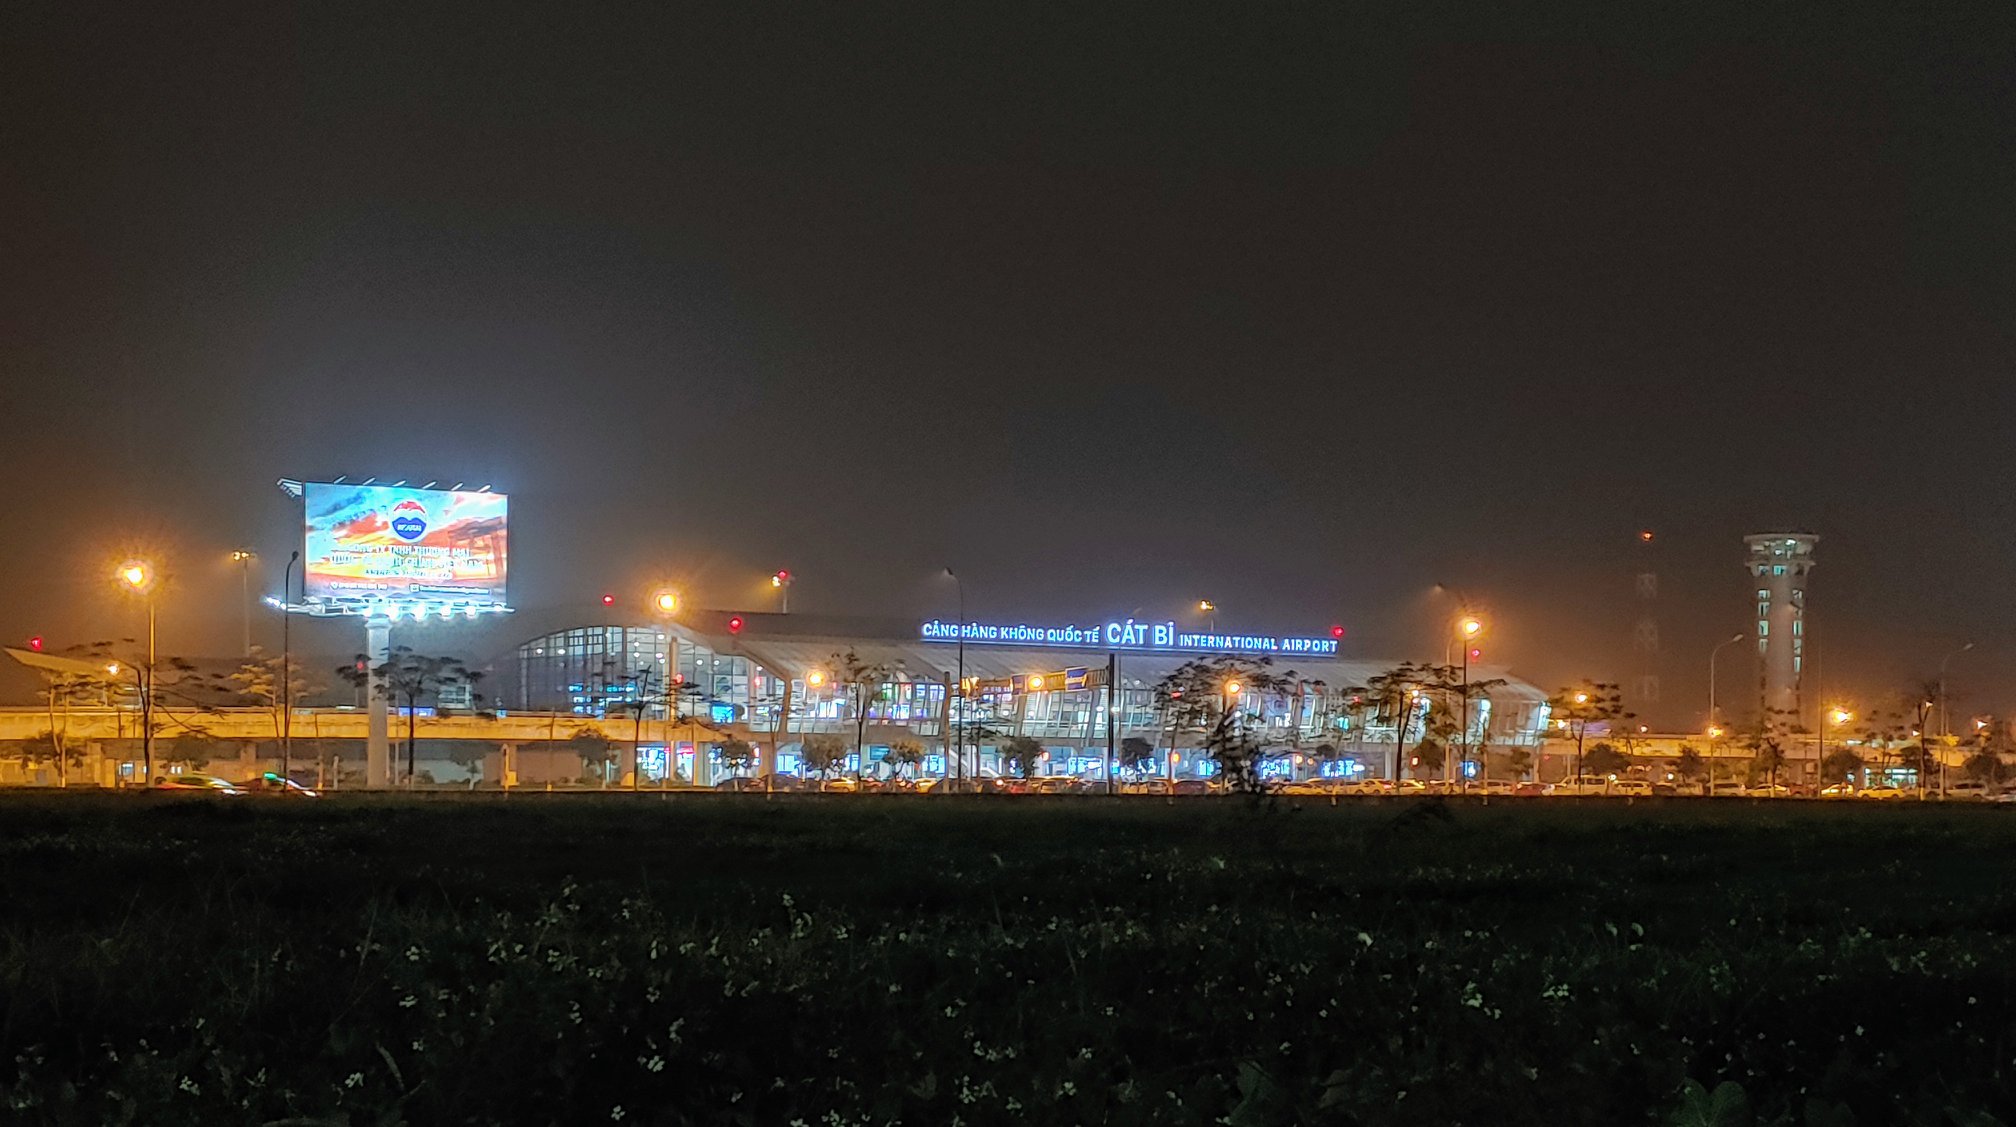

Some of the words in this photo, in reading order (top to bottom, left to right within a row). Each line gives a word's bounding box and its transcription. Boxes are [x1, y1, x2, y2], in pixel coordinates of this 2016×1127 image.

[1001, 625, 1044, 642] KHÔNG
[1047, 625, 1082, 643] QUỐC
[1084, 626, 1101, 644] TẾ
[1106, 618, 1149, 645] CÁT
[1179, 634, 1278, 650] INTERNATIONAL
[1282, 638, 1338, 653] AIRPORT
